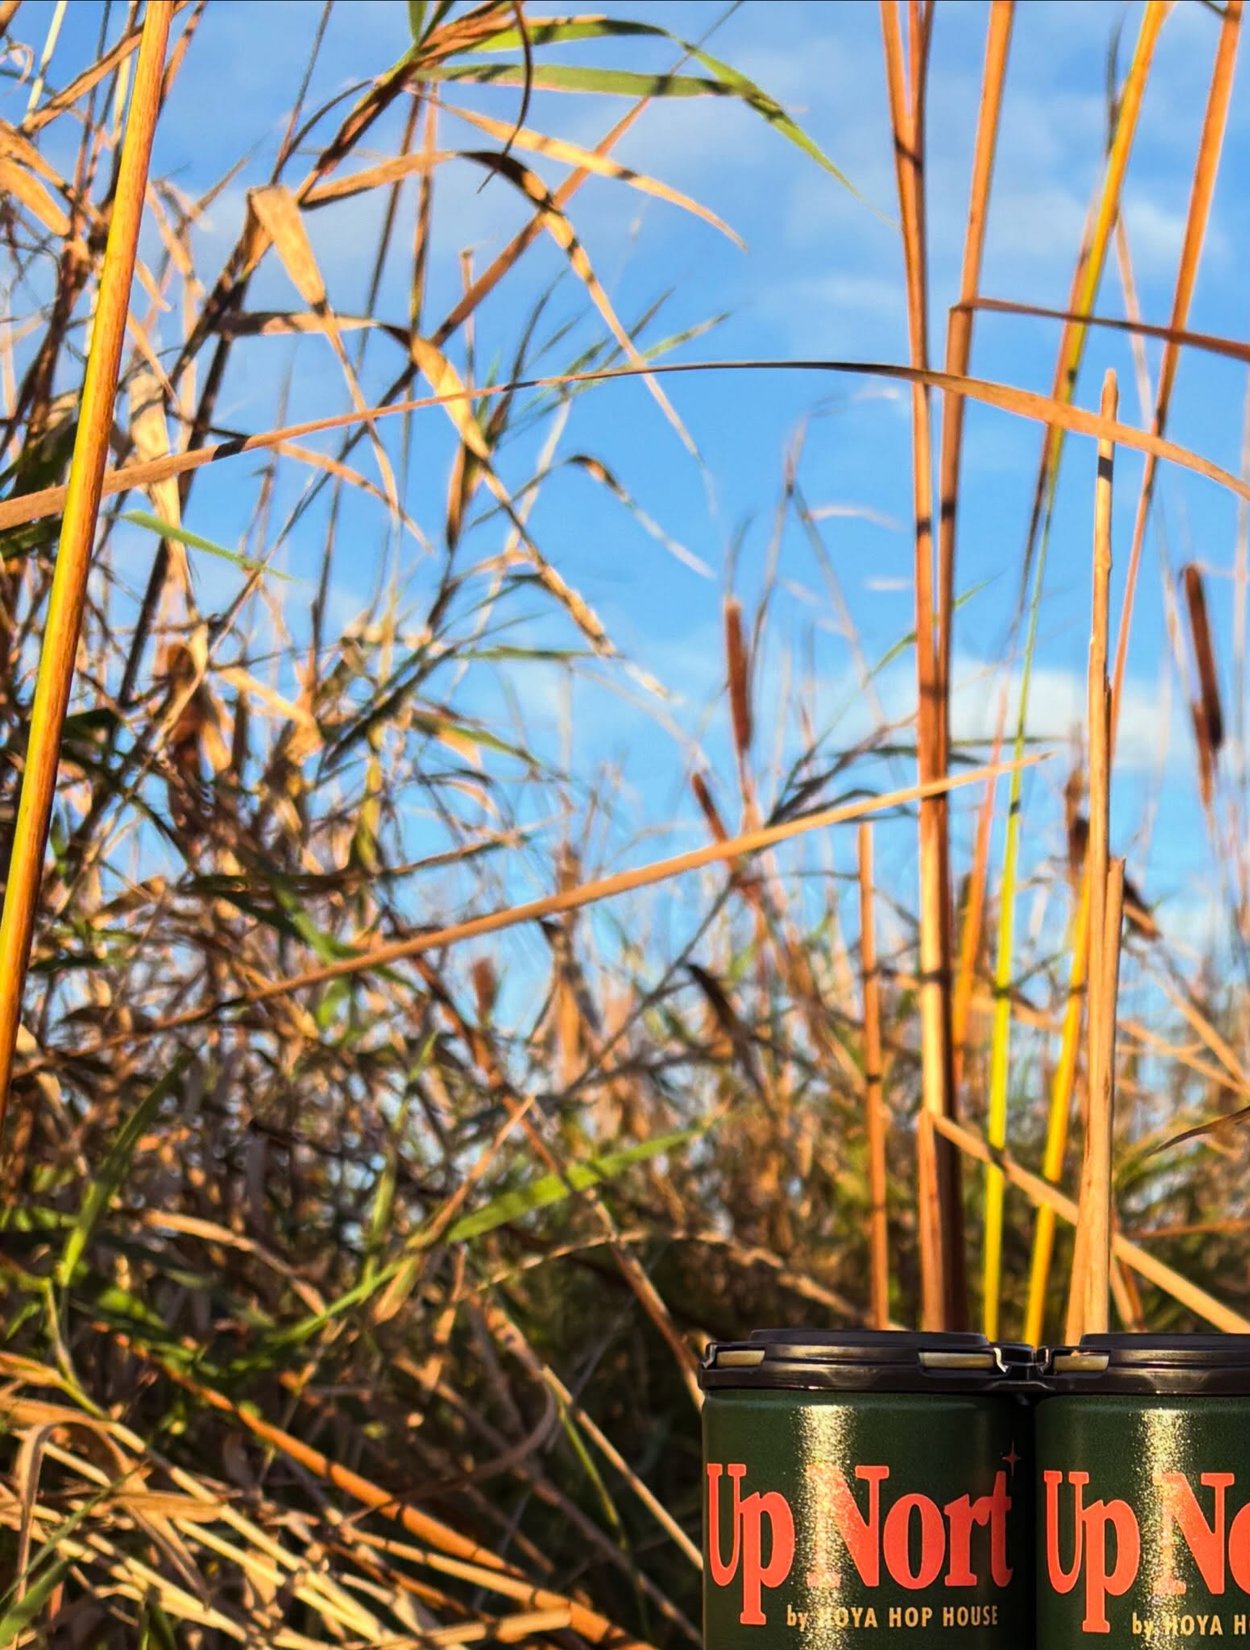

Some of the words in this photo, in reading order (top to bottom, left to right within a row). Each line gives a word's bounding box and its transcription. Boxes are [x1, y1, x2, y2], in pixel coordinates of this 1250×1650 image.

[706, 1463, 795, 1625] Up
[889, 1607, 933, 1627] HOP
[943, 1605, 998, 1626] HOUSE
[1044, 1470, 1141, 1633] Up
